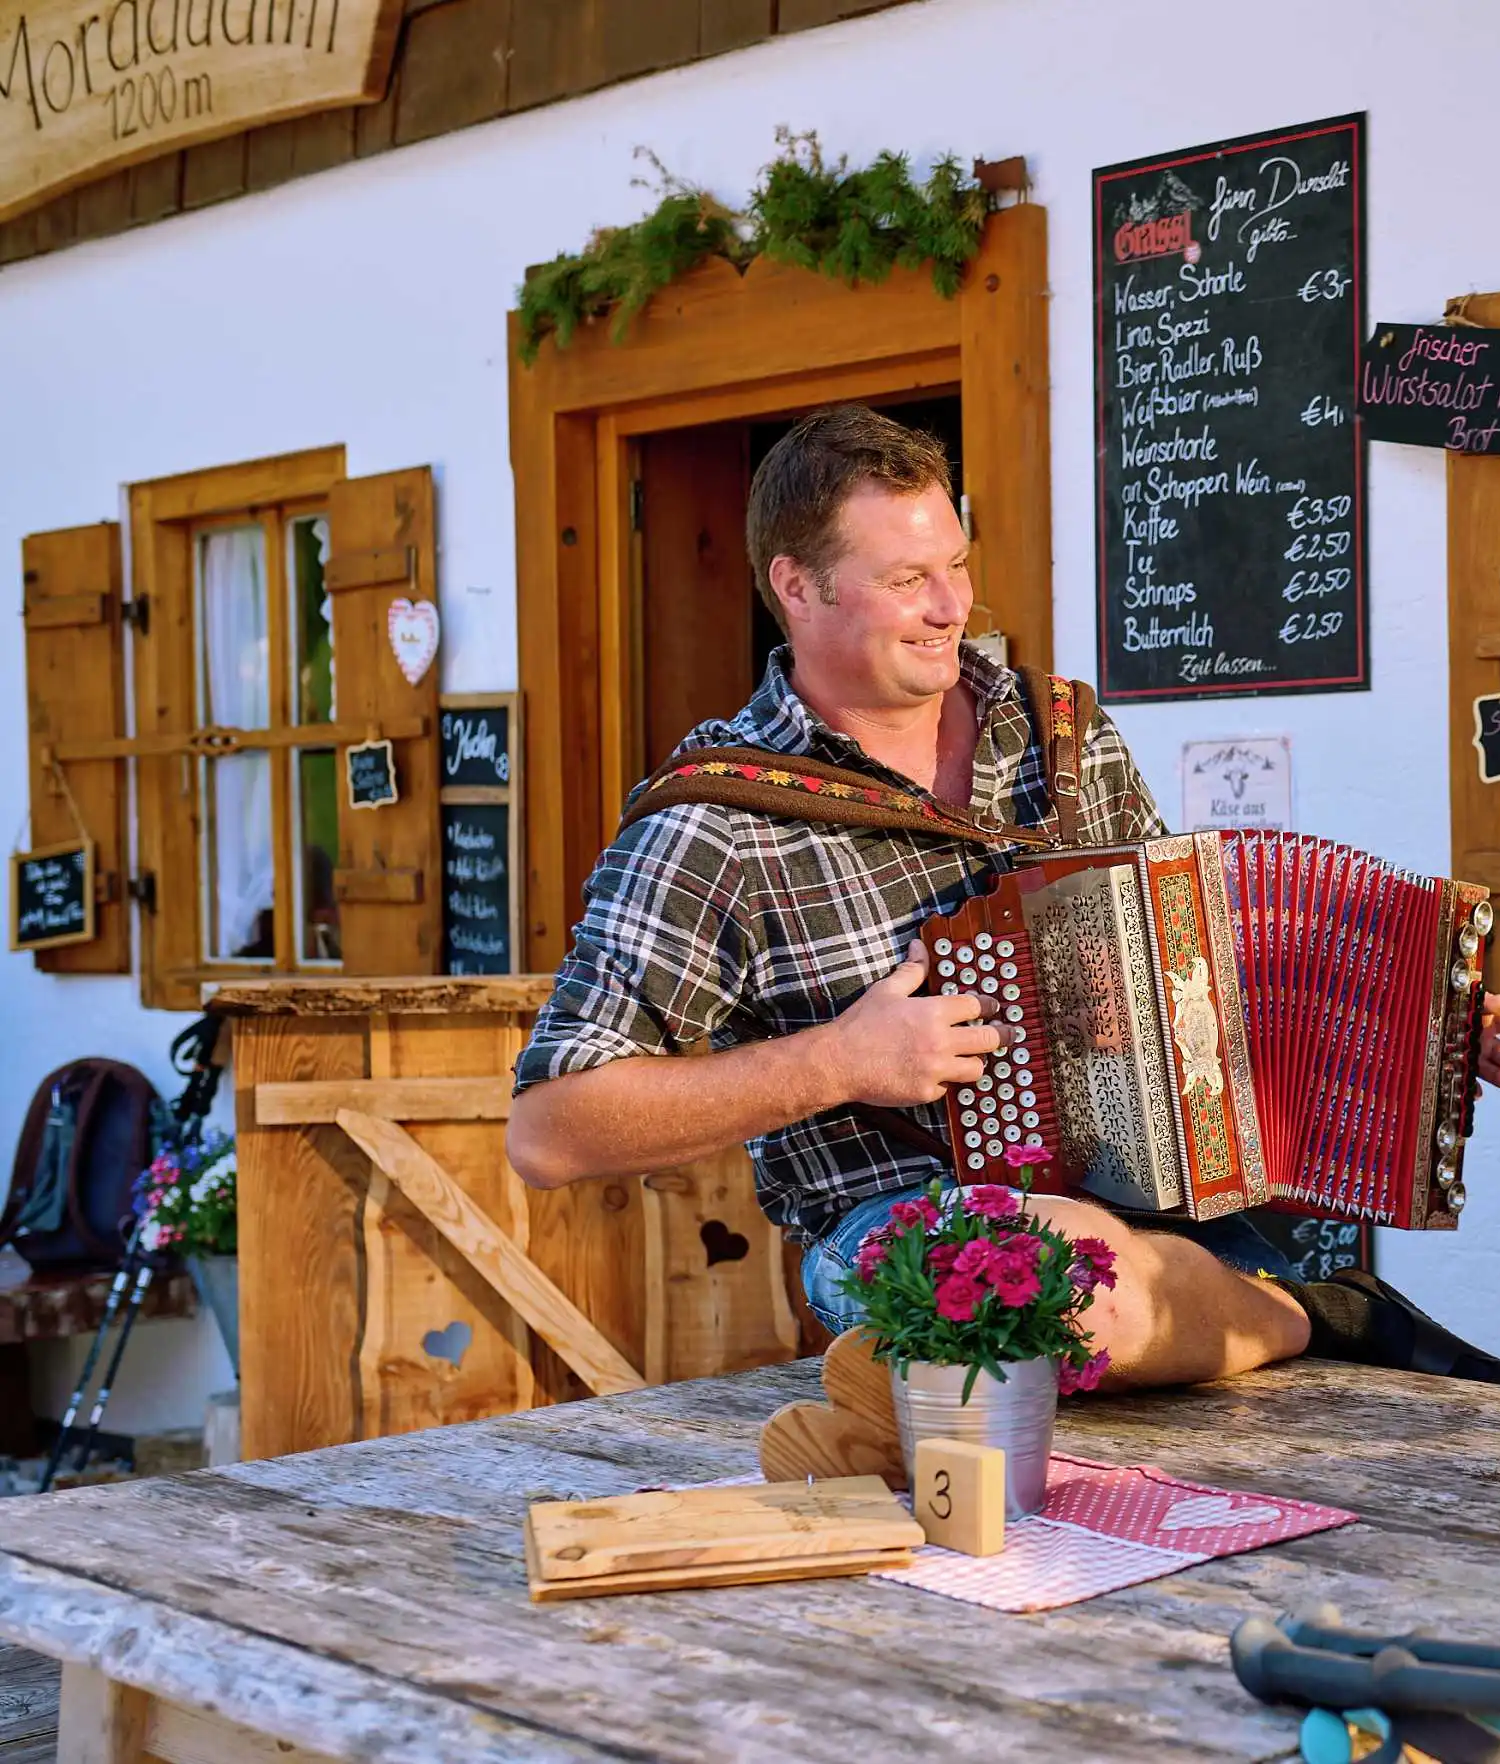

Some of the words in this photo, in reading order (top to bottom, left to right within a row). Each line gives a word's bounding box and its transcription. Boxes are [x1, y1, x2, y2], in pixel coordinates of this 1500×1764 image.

[103, 65, 176, 141] 1200
[1178, 262, 1247, 302] Schorle
[1362, 361, 1495, 410] Wurstsalat
[1121, 424, 1218, 469] Weinschorle
[1144, 466, 1229, 509] Schoppen
[1235, 458, 1271, 496] Wein
[1123, 504, 1180, 546] Kaffee
[1126, 540, 1157, 576] Tee
[1123, 575, 1197, 612] Schnaps
[1123, 610, 1213, 651] Buttermilch
[1179, 654, 1212, 682] Zeit
[1210, 799, 1240, 817] Käse
[1242, 801, 1267, 816] aus
[929, 1469, 952, 1520] 3
